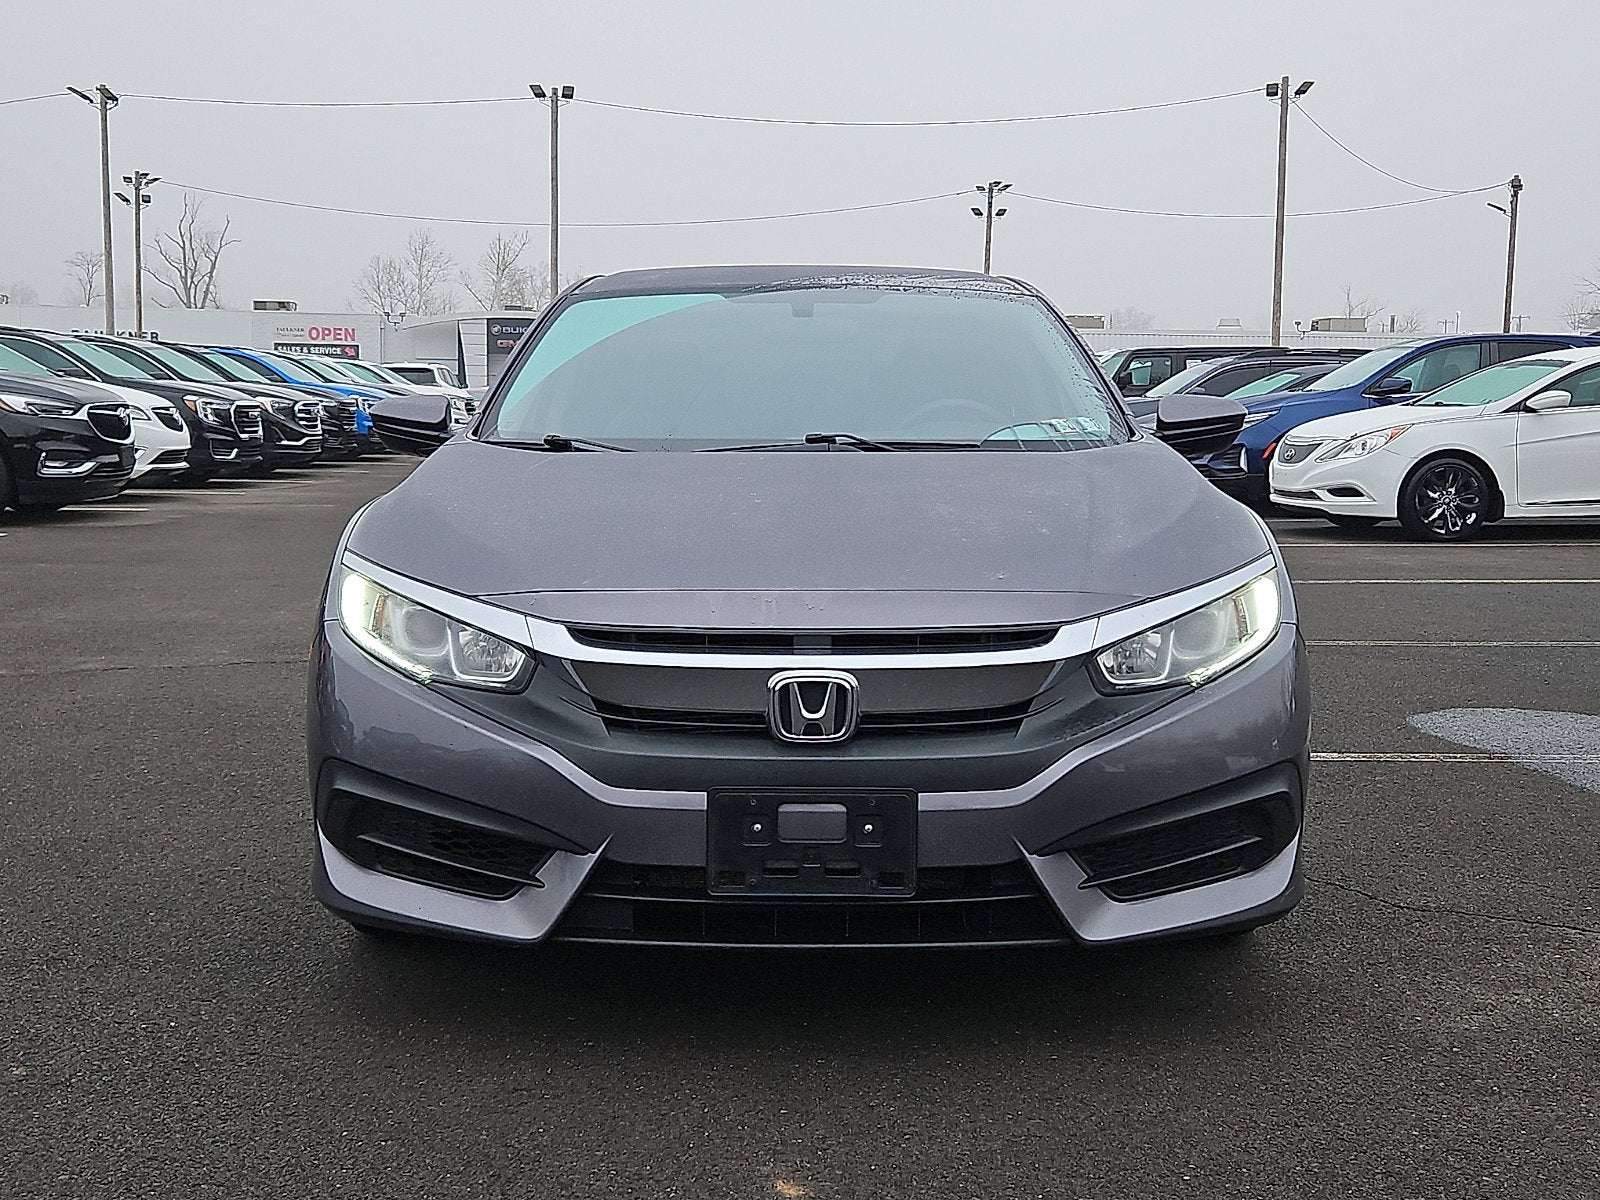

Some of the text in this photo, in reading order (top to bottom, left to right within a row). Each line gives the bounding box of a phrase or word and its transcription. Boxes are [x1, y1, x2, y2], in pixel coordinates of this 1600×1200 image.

[308, 327, 356, 341] OPEN
[502, 326, 529, 334] BUIC
[277, 345, 301, 353] SALES
[310, 346, 342, 354] SERVICE
